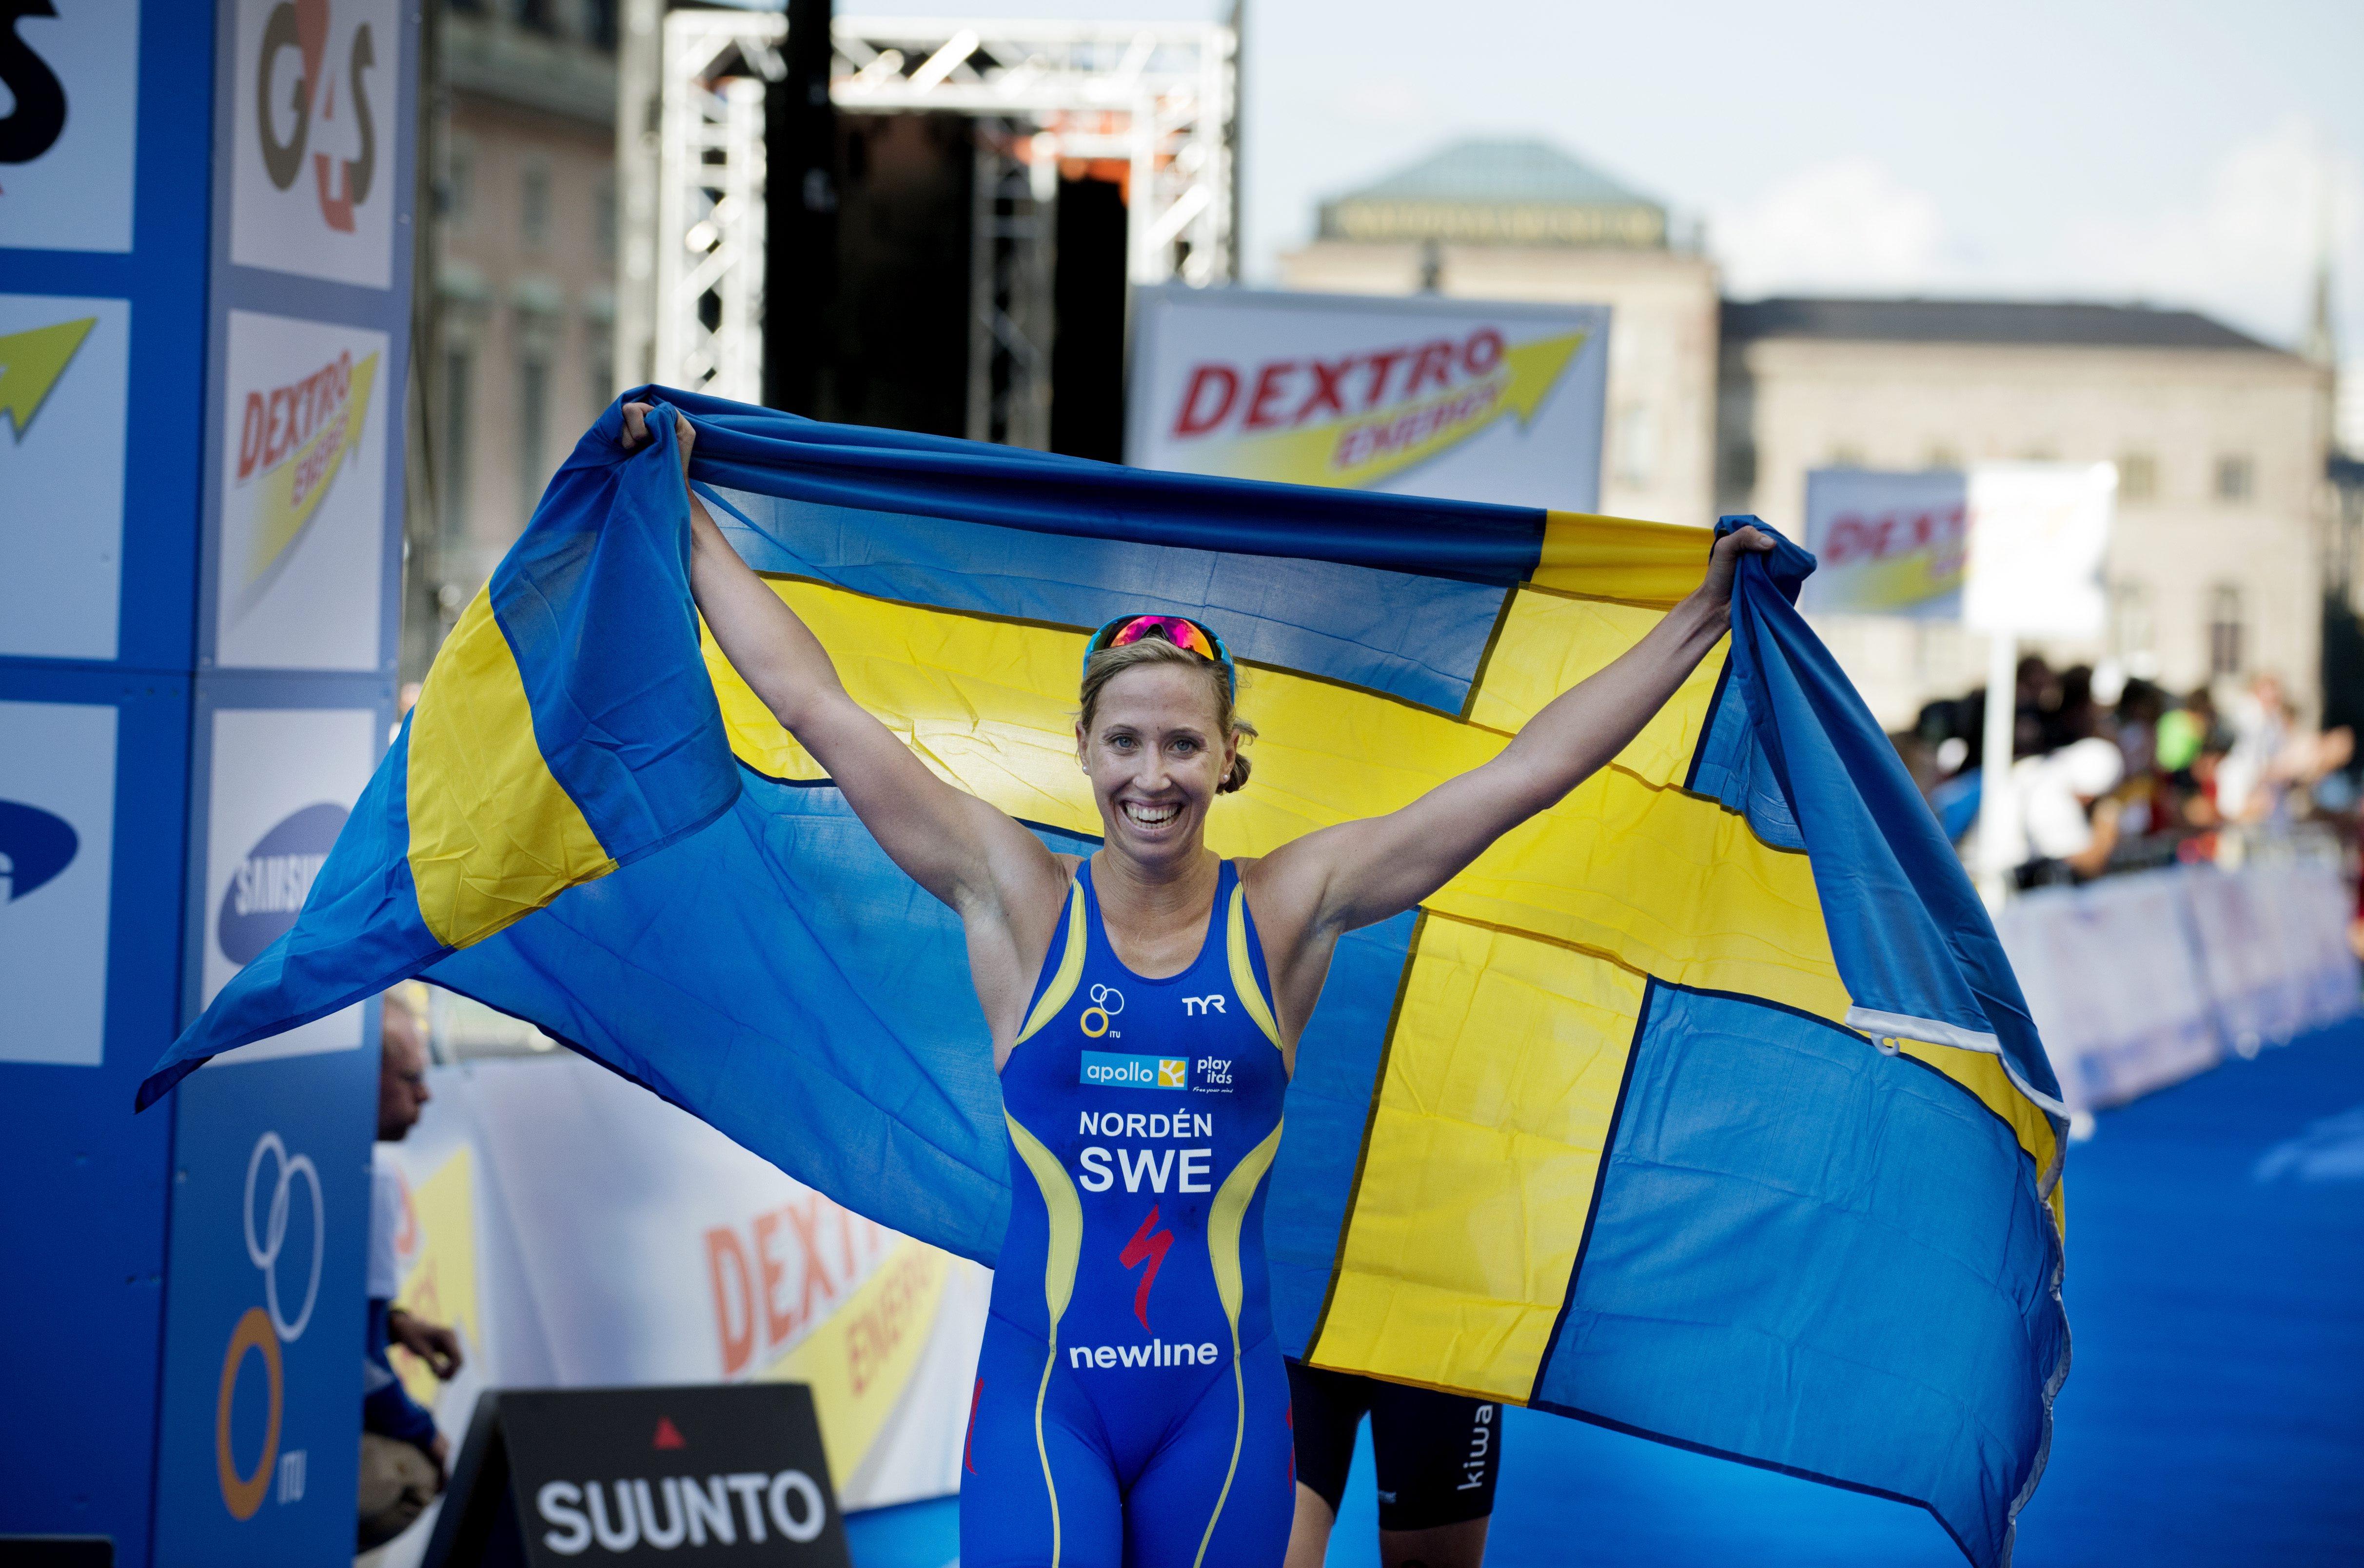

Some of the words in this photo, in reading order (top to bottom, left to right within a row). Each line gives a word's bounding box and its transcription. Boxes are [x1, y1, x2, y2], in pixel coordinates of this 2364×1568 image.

[258, 0, 376, 234] G4S
[1173, 328, 1504, 437] DEXTRO
[237, 348, 352, 480] DEXTRO
[236, 854, 332, 916] SAMSU
[1182, 994, 1226, 1016] TYR
[1109, 1030, 1121, 1039] ITU
[1087, 1061, 1153, 1083] apollo
[1197, 1056, 1232, 1074] play
[1207, 1069, 1232, 1084] itas
[1079, 1108, 1212, 1138] NORDÉN
[1079, 1146, 1212, 1194] SWE
[537, 1468, 825, 1555] SUUNTO
